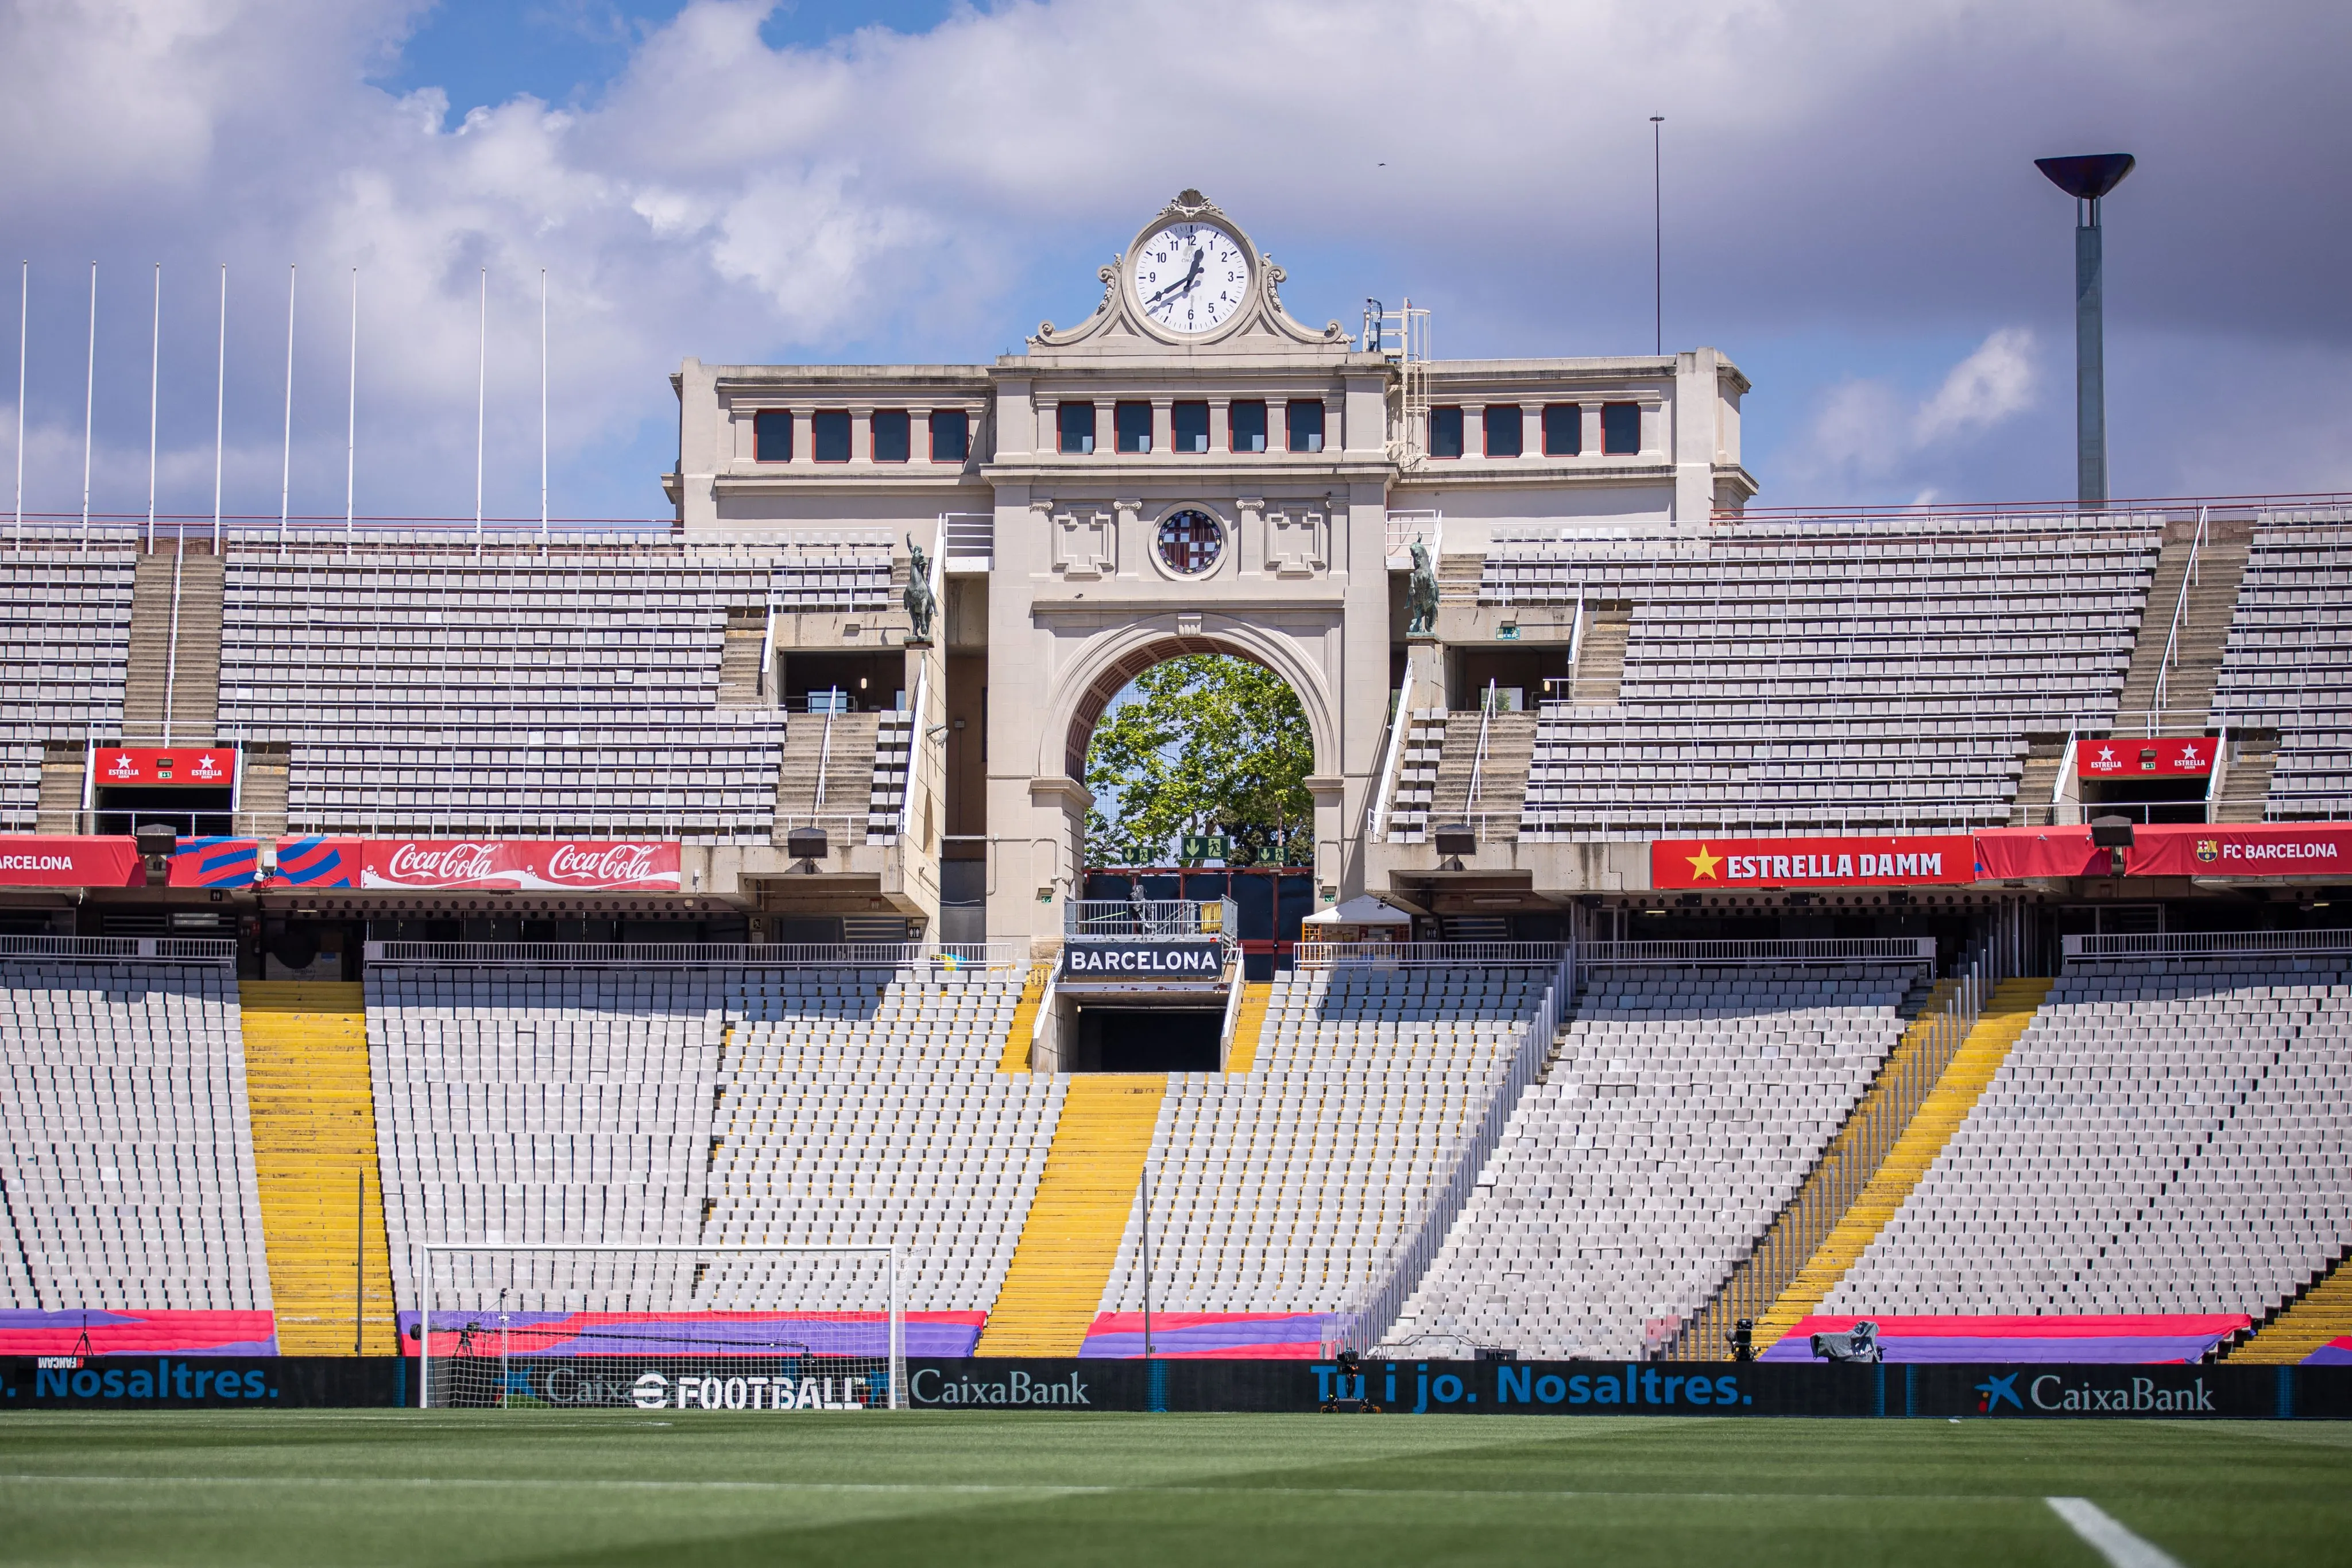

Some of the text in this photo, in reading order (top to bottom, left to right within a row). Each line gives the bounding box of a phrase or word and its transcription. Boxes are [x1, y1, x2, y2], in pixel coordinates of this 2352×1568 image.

[1170, 240, 1178, 251] 11
[1186, 235, 1196, 246] 12
[1209, 240, 1213, 250] 1
[1156, 252, 1166, 263] 10
[1221, 251, 1228, 262] 2
[1150, 272, 1156, 282] 9
[1228, 271, 1233, 282] 3
[1220, 291, 1227, 301] 4
[1167, 303, 1173, 313] 7
[1208, 303, 1214, 313] 5
[1187, 309, 1194, 320] 6
[2223, 843, 2338, 859] FC BARCELONA
[390, 843, 498, 878] Coca-Cola
[548, 844, 657, 879] Coca-Cola
[1727, 853, 1942, 879] ESTRELLA DAMM
[1071, 951, 1217, 970] BARCELONA
[38, 1357, 84, 1369] #FANCAM
[36, 1359, 278, 1399] Nosaltres.
[911, 1369, 1090, 1404] CaixaBank
[1310, 1364, 1753, 1415] Tu i jo. Nosaltres.
[2030, 1375, 2216, 1411] CaixaBank
